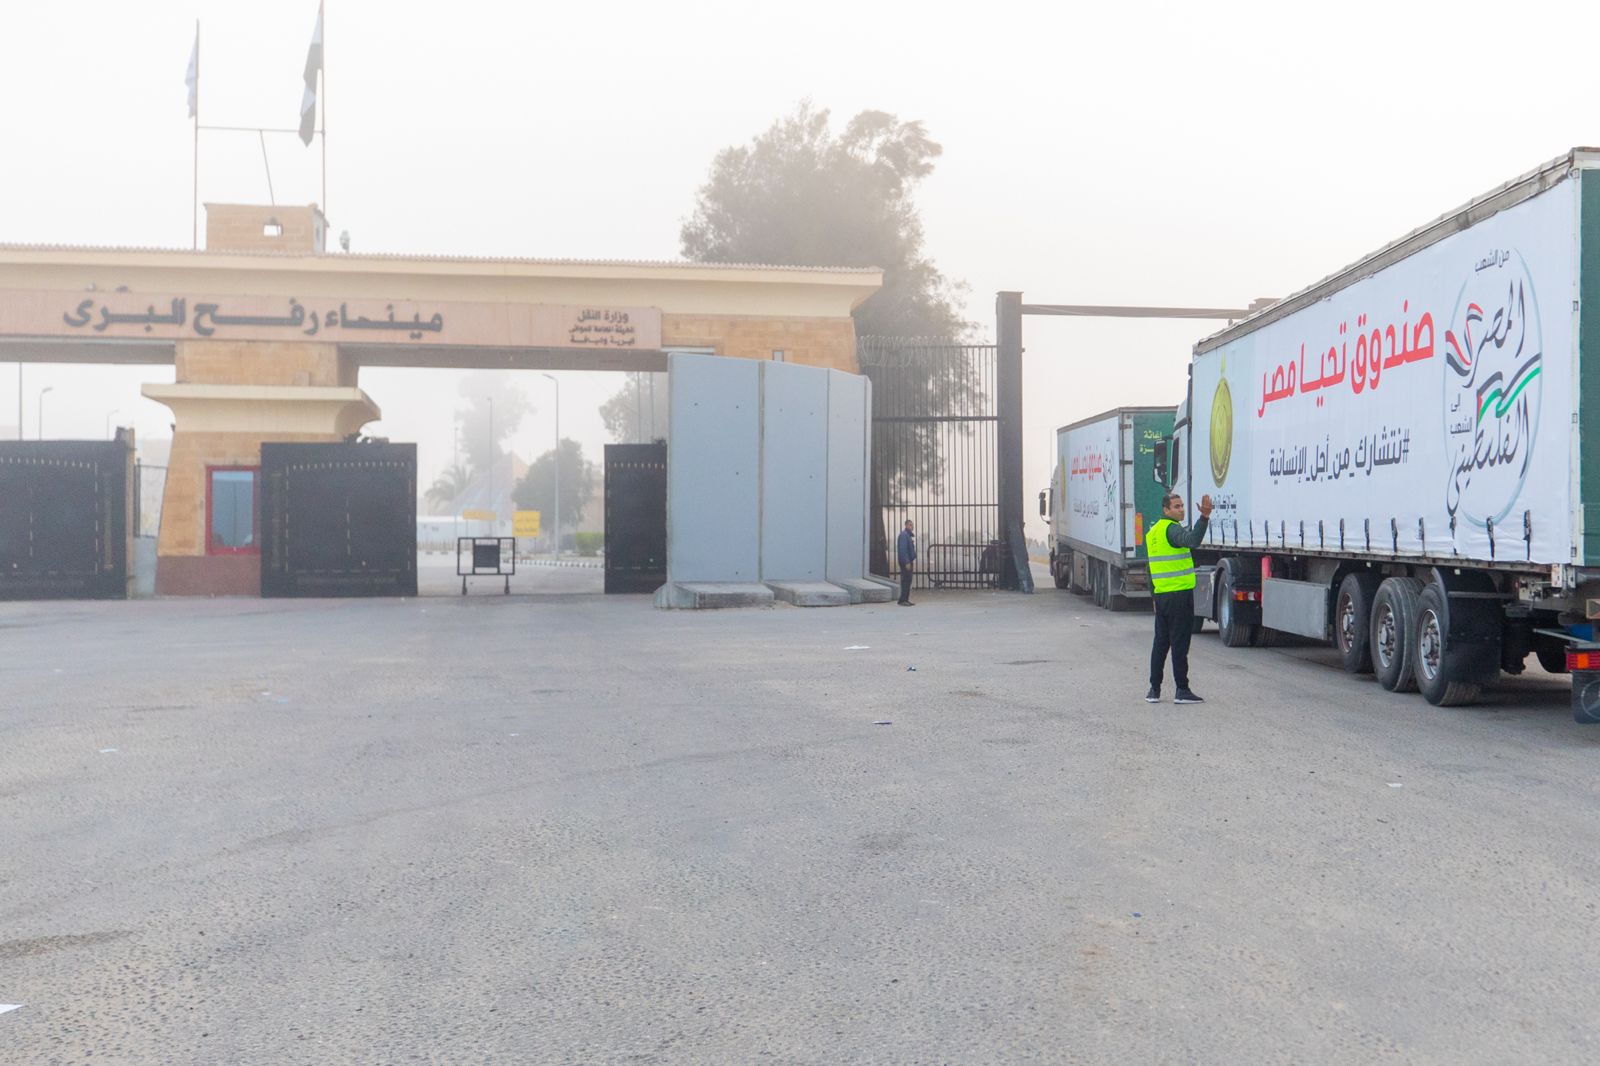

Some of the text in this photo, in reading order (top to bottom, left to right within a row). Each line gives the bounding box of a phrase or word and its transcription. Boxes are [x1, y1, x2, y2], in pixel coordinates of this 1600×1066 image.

[193, 297, 319, 337] رفح
[1257, 299, 1435, 418] صندوق تحيا مصر
